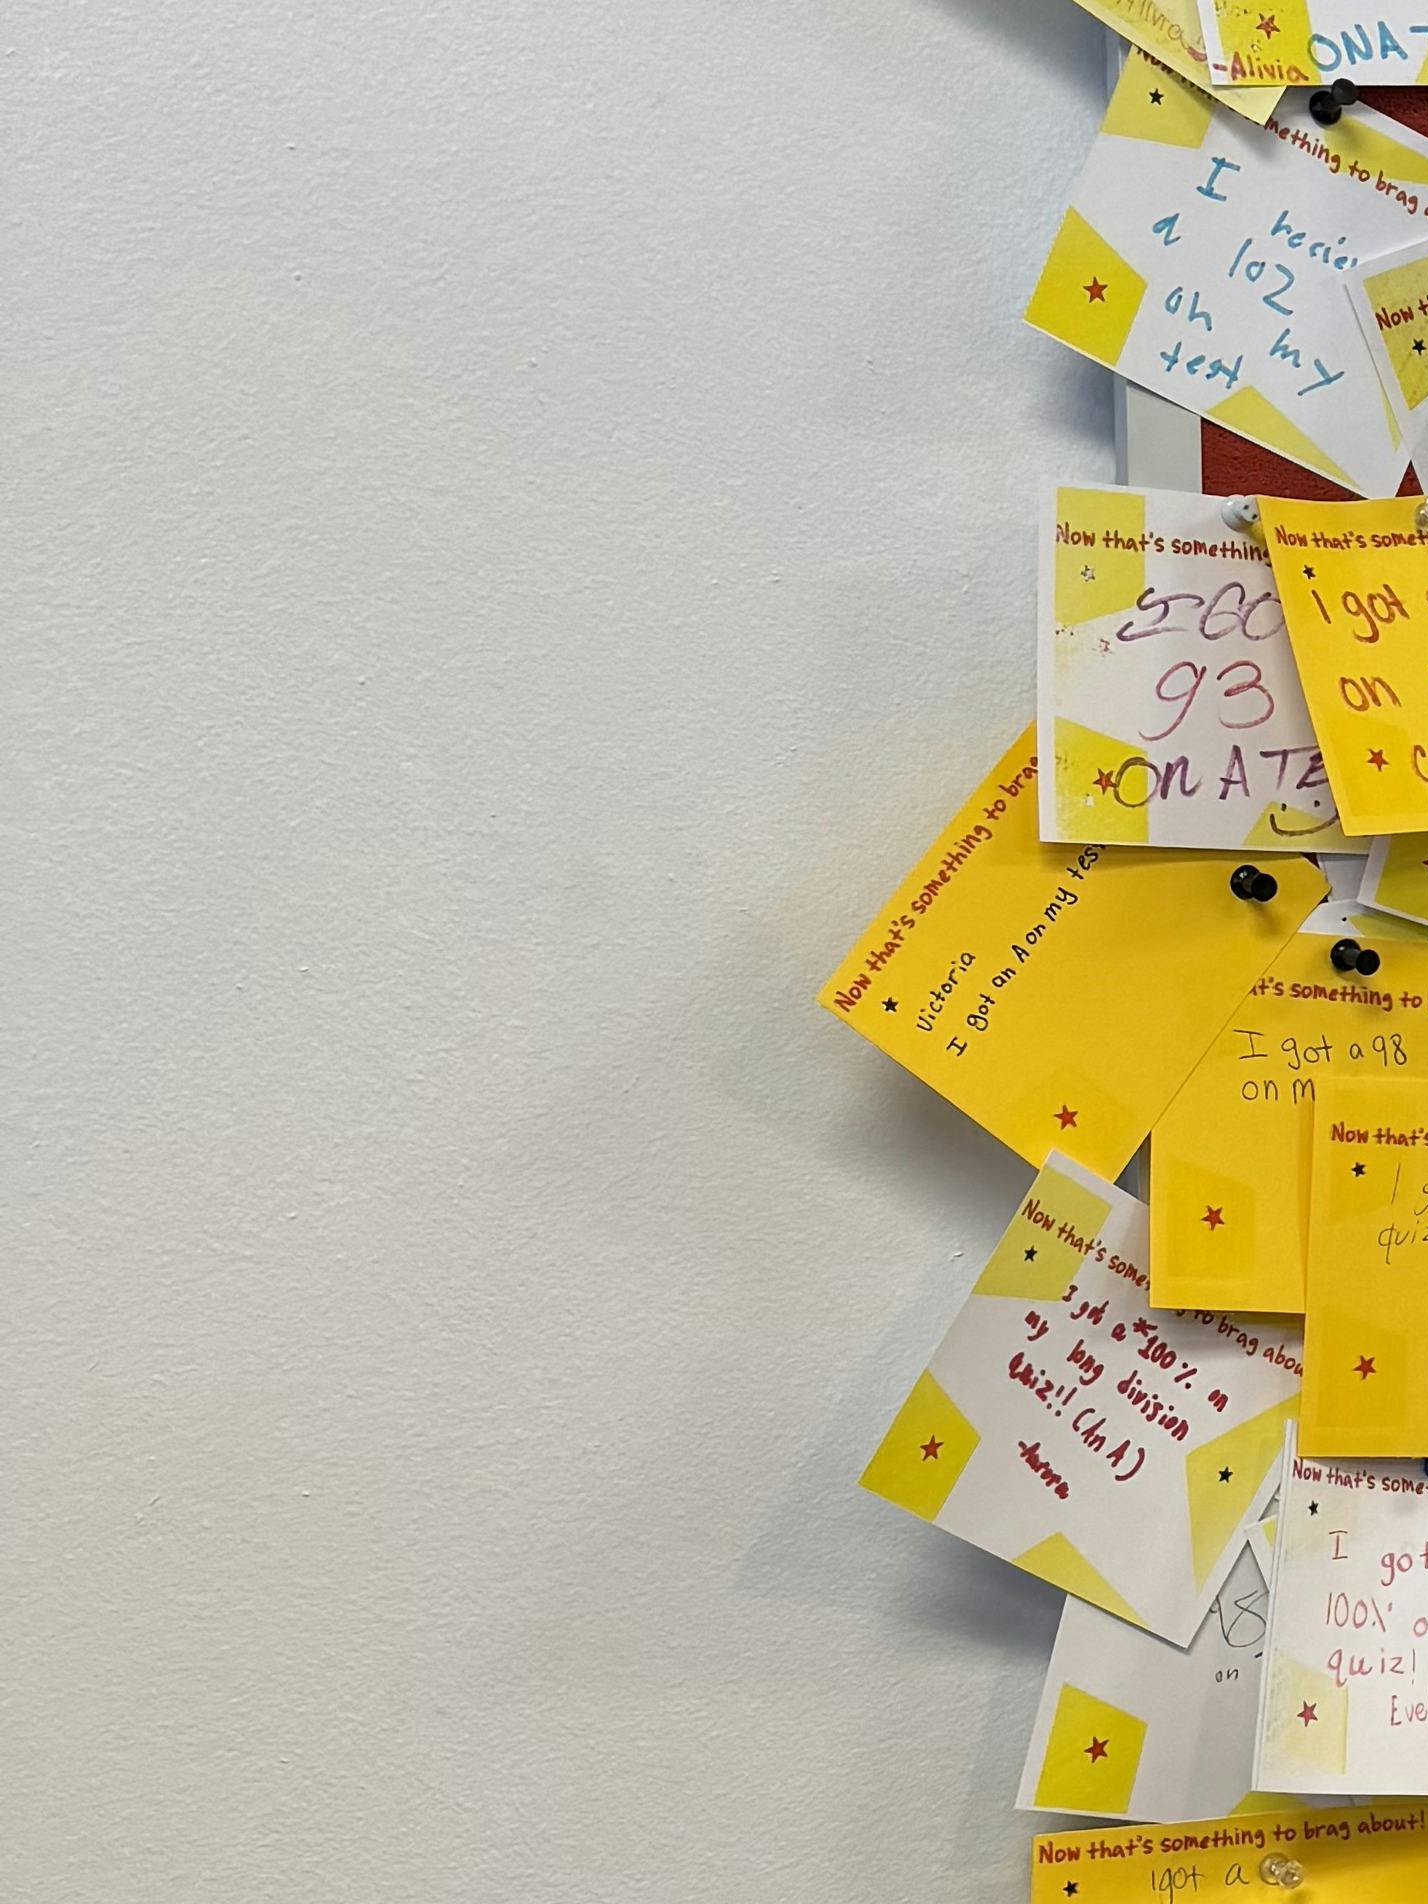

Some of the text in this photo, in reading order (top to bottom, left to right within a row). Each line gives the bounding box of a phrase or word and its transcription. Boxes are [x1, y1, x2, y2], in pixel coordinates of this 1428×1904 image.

[1275, 525, 1307, 546] Now
[1310, 529, 1365, 551] that's
[1342, 584, 1410, 646] got
[1340, 673, 1401, 714] on
[916, 951, 976, 1033] Victoria
[947, 886, 1079, 1057] I got an A on my
